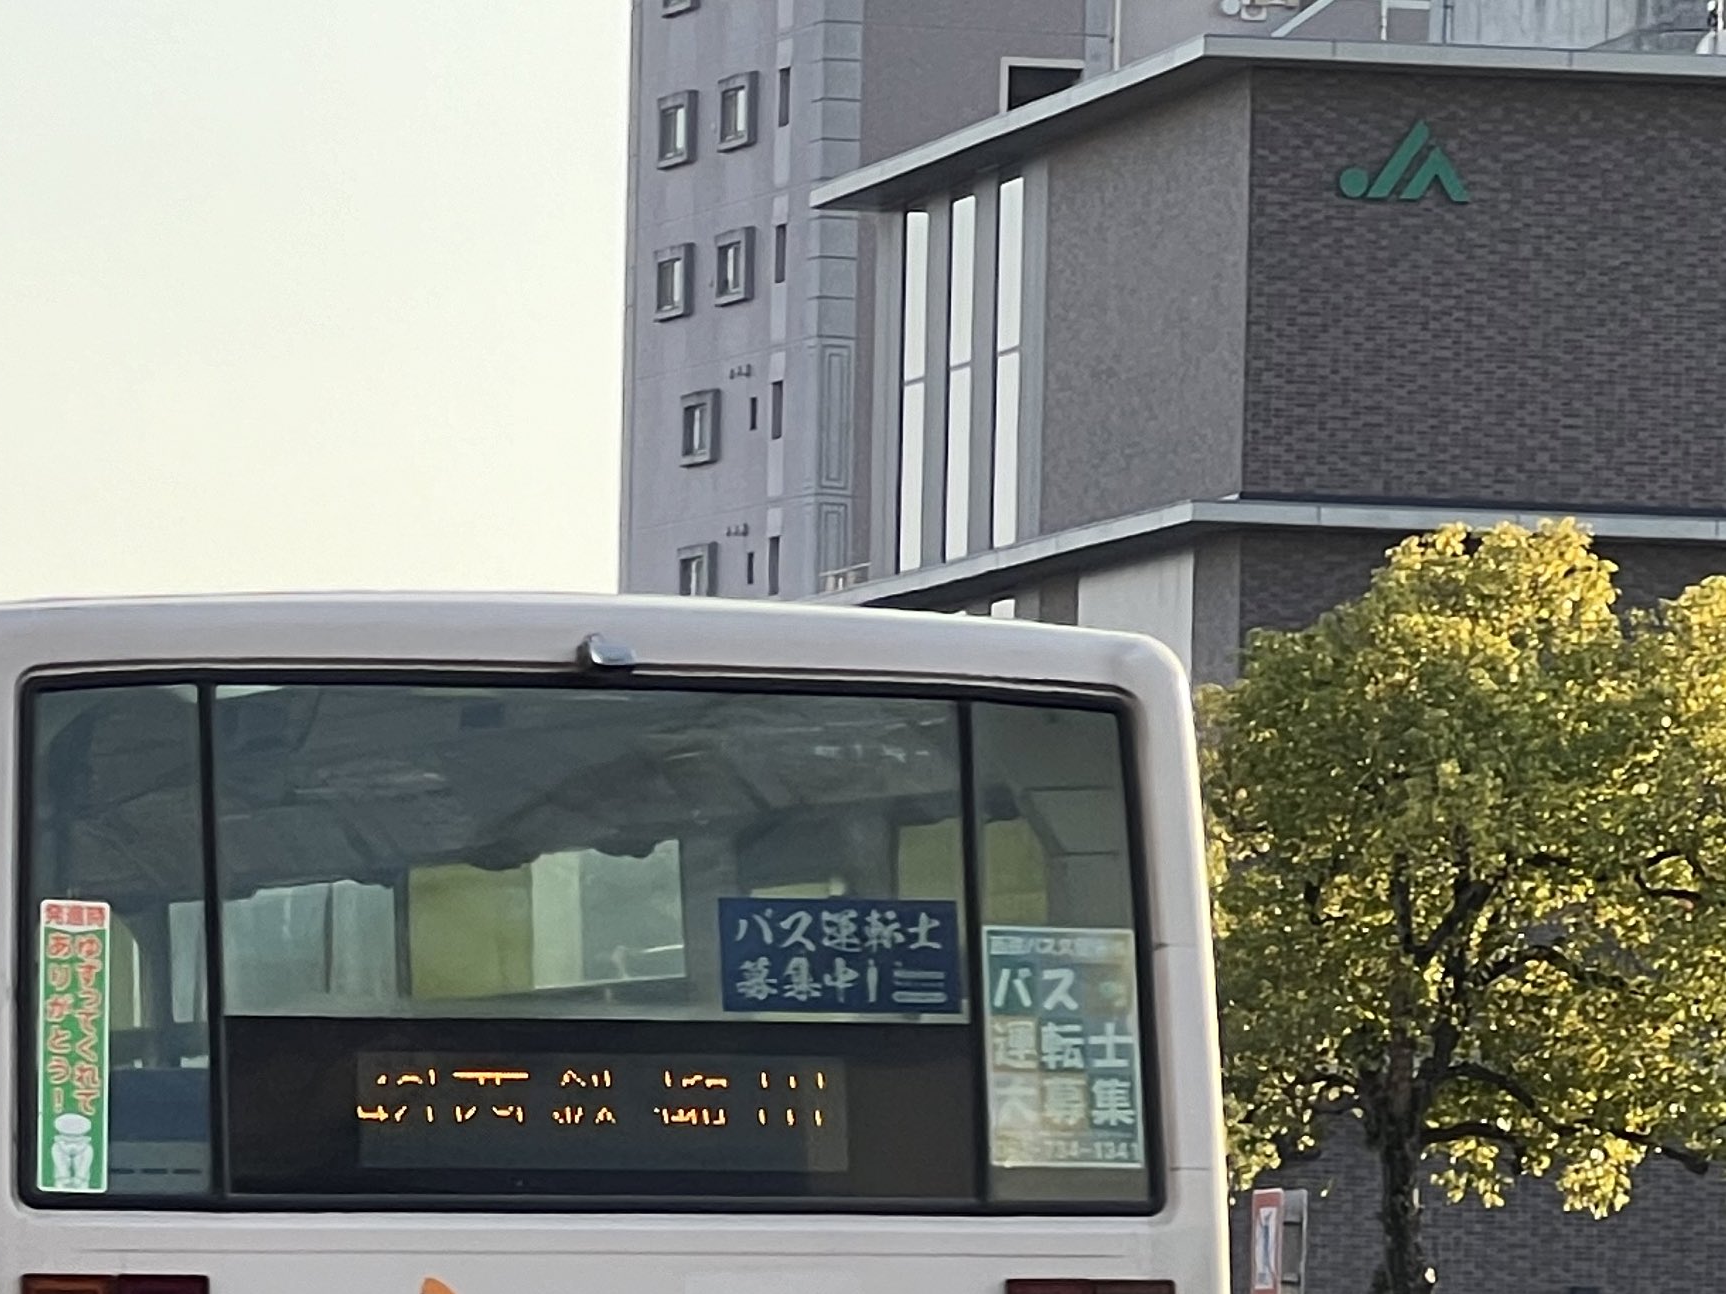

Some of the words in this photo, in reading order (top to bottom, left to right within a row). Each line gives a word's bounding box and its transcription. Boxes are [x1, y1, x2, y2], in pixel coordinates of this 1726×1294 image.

[735, 908, 943, 952] バス運転士
[993, 966, 1079, 1011] バス
[993, 1020, 1134, 1070] 運転士
